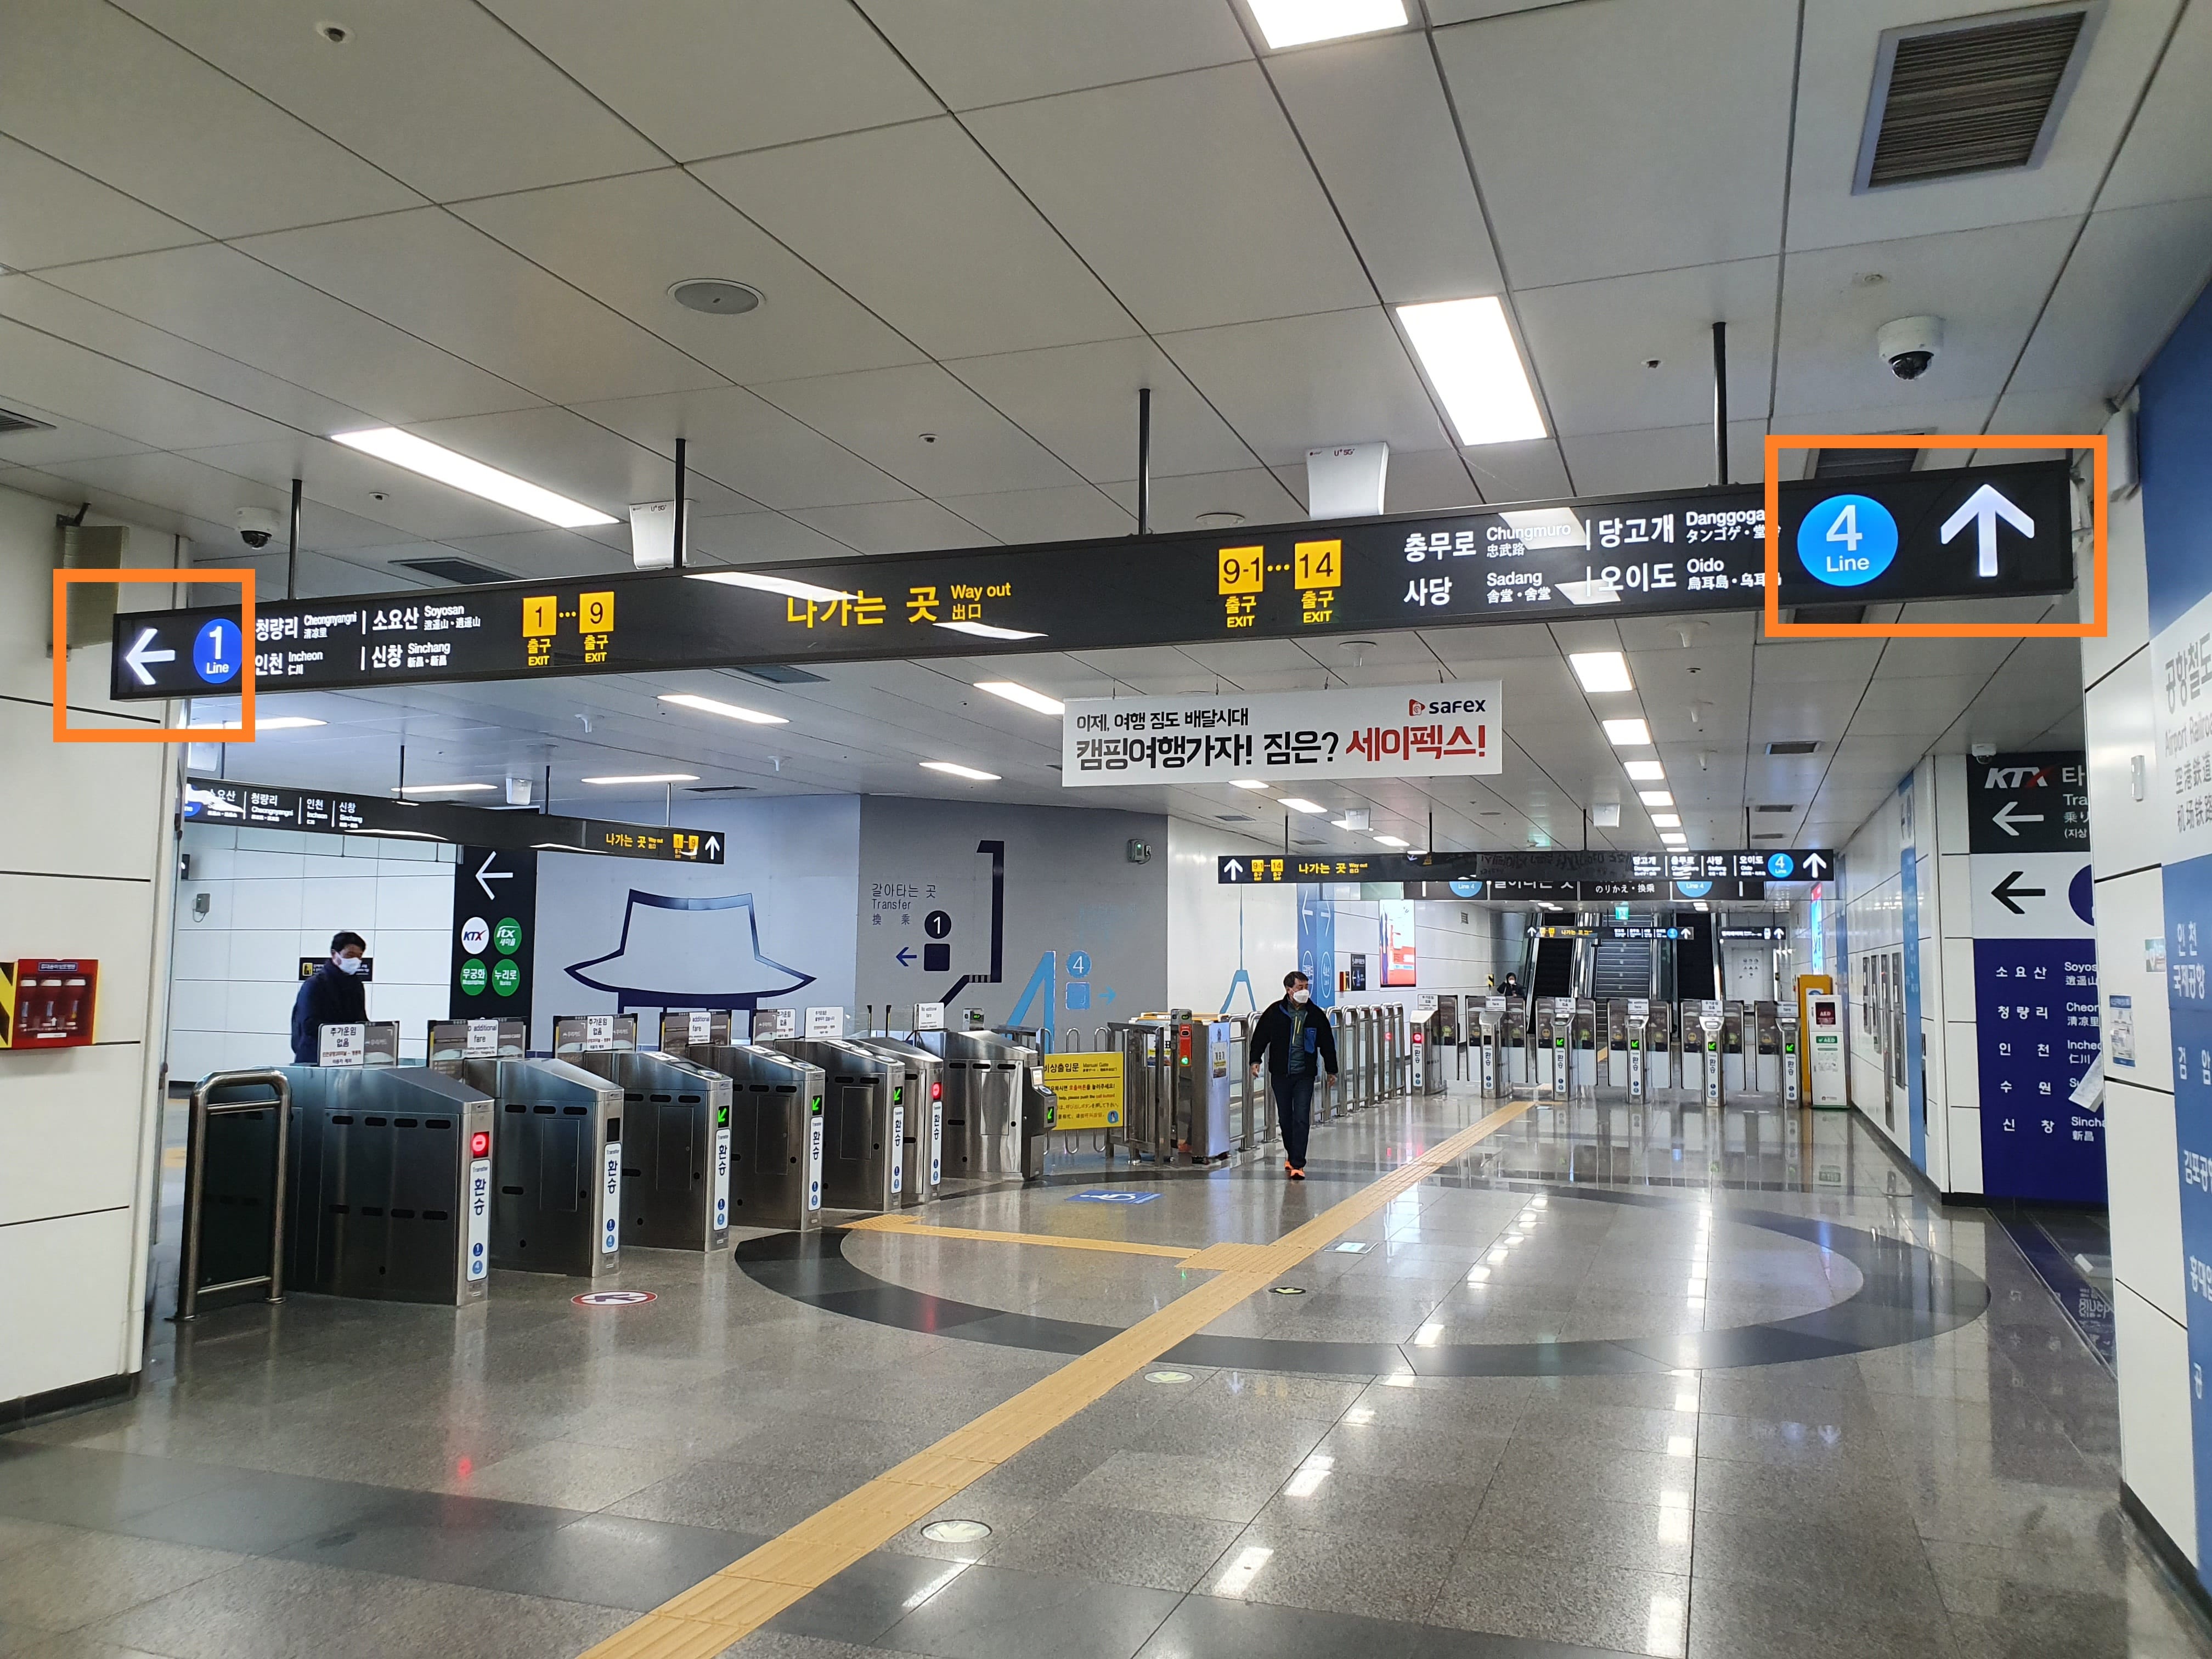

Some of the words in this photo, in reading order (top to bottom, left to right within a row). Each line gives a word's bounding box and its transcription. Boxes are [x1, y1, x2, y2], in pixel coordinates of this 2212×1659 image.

[1686, 509, 1765, 529] Danggoga
[1826, 504, 1863, 551] 4
[1486, 522, 1571, 544] Chungmuro
[1599, 513, 1675, 548] 당고개
[1404, 531, 1477, 563] 충무로
[1487, 542, 1525, 558] 忠武路
[1223, 557, 1260, 584] 9-1
[1299, 552, 1334, 579] 14
[1687, 558, 1724, 574] Oido
[1826, 556, 1869, 572] Line
[1487, 570, 1542, 589] Sadang
[1598, 562, 1677, 592] 오이도
[951, 583, 983, 602] Way
[986, 582, 1011, 598] out
[1301, 591, 1334, 610] 출구
[1403, 577, 1452, 607] 사당
[424, 605, 464, 618] Soyosan
[590, 602, 603, 624] 9
[787, 590, 887, 628] 나가는
[906, 586, 939, 622] 곳
[952, 603, 981, 620] 出口
[1225, 596, 1256, 614] 출구
[303, 612, 357, 626] Cheongnyangni
[373, 607, 419, 630] 소요산
[535, 606, 542, 628] 1
[1227, 615, 1255, 628] EXIT
[1303, 610, 1332, 623] EXIT
[255, 617, 298, 641] 청량리
[210, 626, 222, 659] 1
[408, 642, 450, 654] Sinchang
[528, 639, 550, 654] 출구
[584, 635, 608, 651] 출구
[255, 653, 283, 676] 인천
[288, 650, 323, 662] Incheon
[371, 644, 402, 669] 신창
[528, 656, 549, 666] EXIT
[585, 652, 607, 663] EXIT
[206, 662, 229, 675] Line
[287, 663, 303, 675] 仁川
[2165, 633, 2212, 714] 공항철도
[1076, 715, 1110, 733] 이제,
[1114, 712, 1146, 731] 여행
[1150, 711, 1181, 729] 짐도
[1184, 708, 1249, 728] 배달시대
[1076, 733, 1252, 771] 캠핑여행가자!
[1263, 730, 1339, 765] 짐은?
[1345, 725, 1485, 762] 세이펙스!
[2165, 725, 2187, 758] Airport
[1984, 766, 2052, 789] KTX
[251, 793, 278, 806] 청량리
[307, 799, 323, 810] 인천
[339, 802, 356, 813] 신창
[606, 833, 633, 847] 나가는
[637, 836, 646, 849] 곳
[1299, 863, 1330, 874] 나가는
[1335, 863, 1346, 873] 곳
[1706, 856, 1723, 865] 사당
[1739, 856, 1764, 864] 오이도
[1775, 856, 1785, 868] 4
[872, 884, 918, 897] 갈아타는
[926, 885, 936, 898] 곳
[872, 899, 911, 910] Transfer
[934, 917, 941, 934] 1
[463, 930, 487, 941] KTX
[2177, 921, 2197, 956] 인천
[1073, 956, 1084, 973] 4
[2064, 962, 2096, 973] Soyos
[463, 969, 485, 979] 무궁화
[495, 970, 517, 980] 누리로
[1996, 967, 2047, 980] 소요산
[2173, 963, 2205, 1000] 국제공항
[1997, 1006, 2048, 1020] 청량리
[330, 1027, 356, 1036] 추가운임
[337, 1039, 349, 1047] 없음
[2069, 1054, 2090, 1064] 仁川
[1043, 1063, 1079, 1073] 비상출입문
[895, 1119, 902, 1147] 환승
[934, 1115, 940, 1140] 환승
[2072, 1130, 2094, 1141] 新昌
[812, 1131, 821, 1160] 환승
[718, 1144, 727, 1176] 환승
[607, 1160, 618, 1194] 환승
[474, 1178, 486, 1216] 환승
